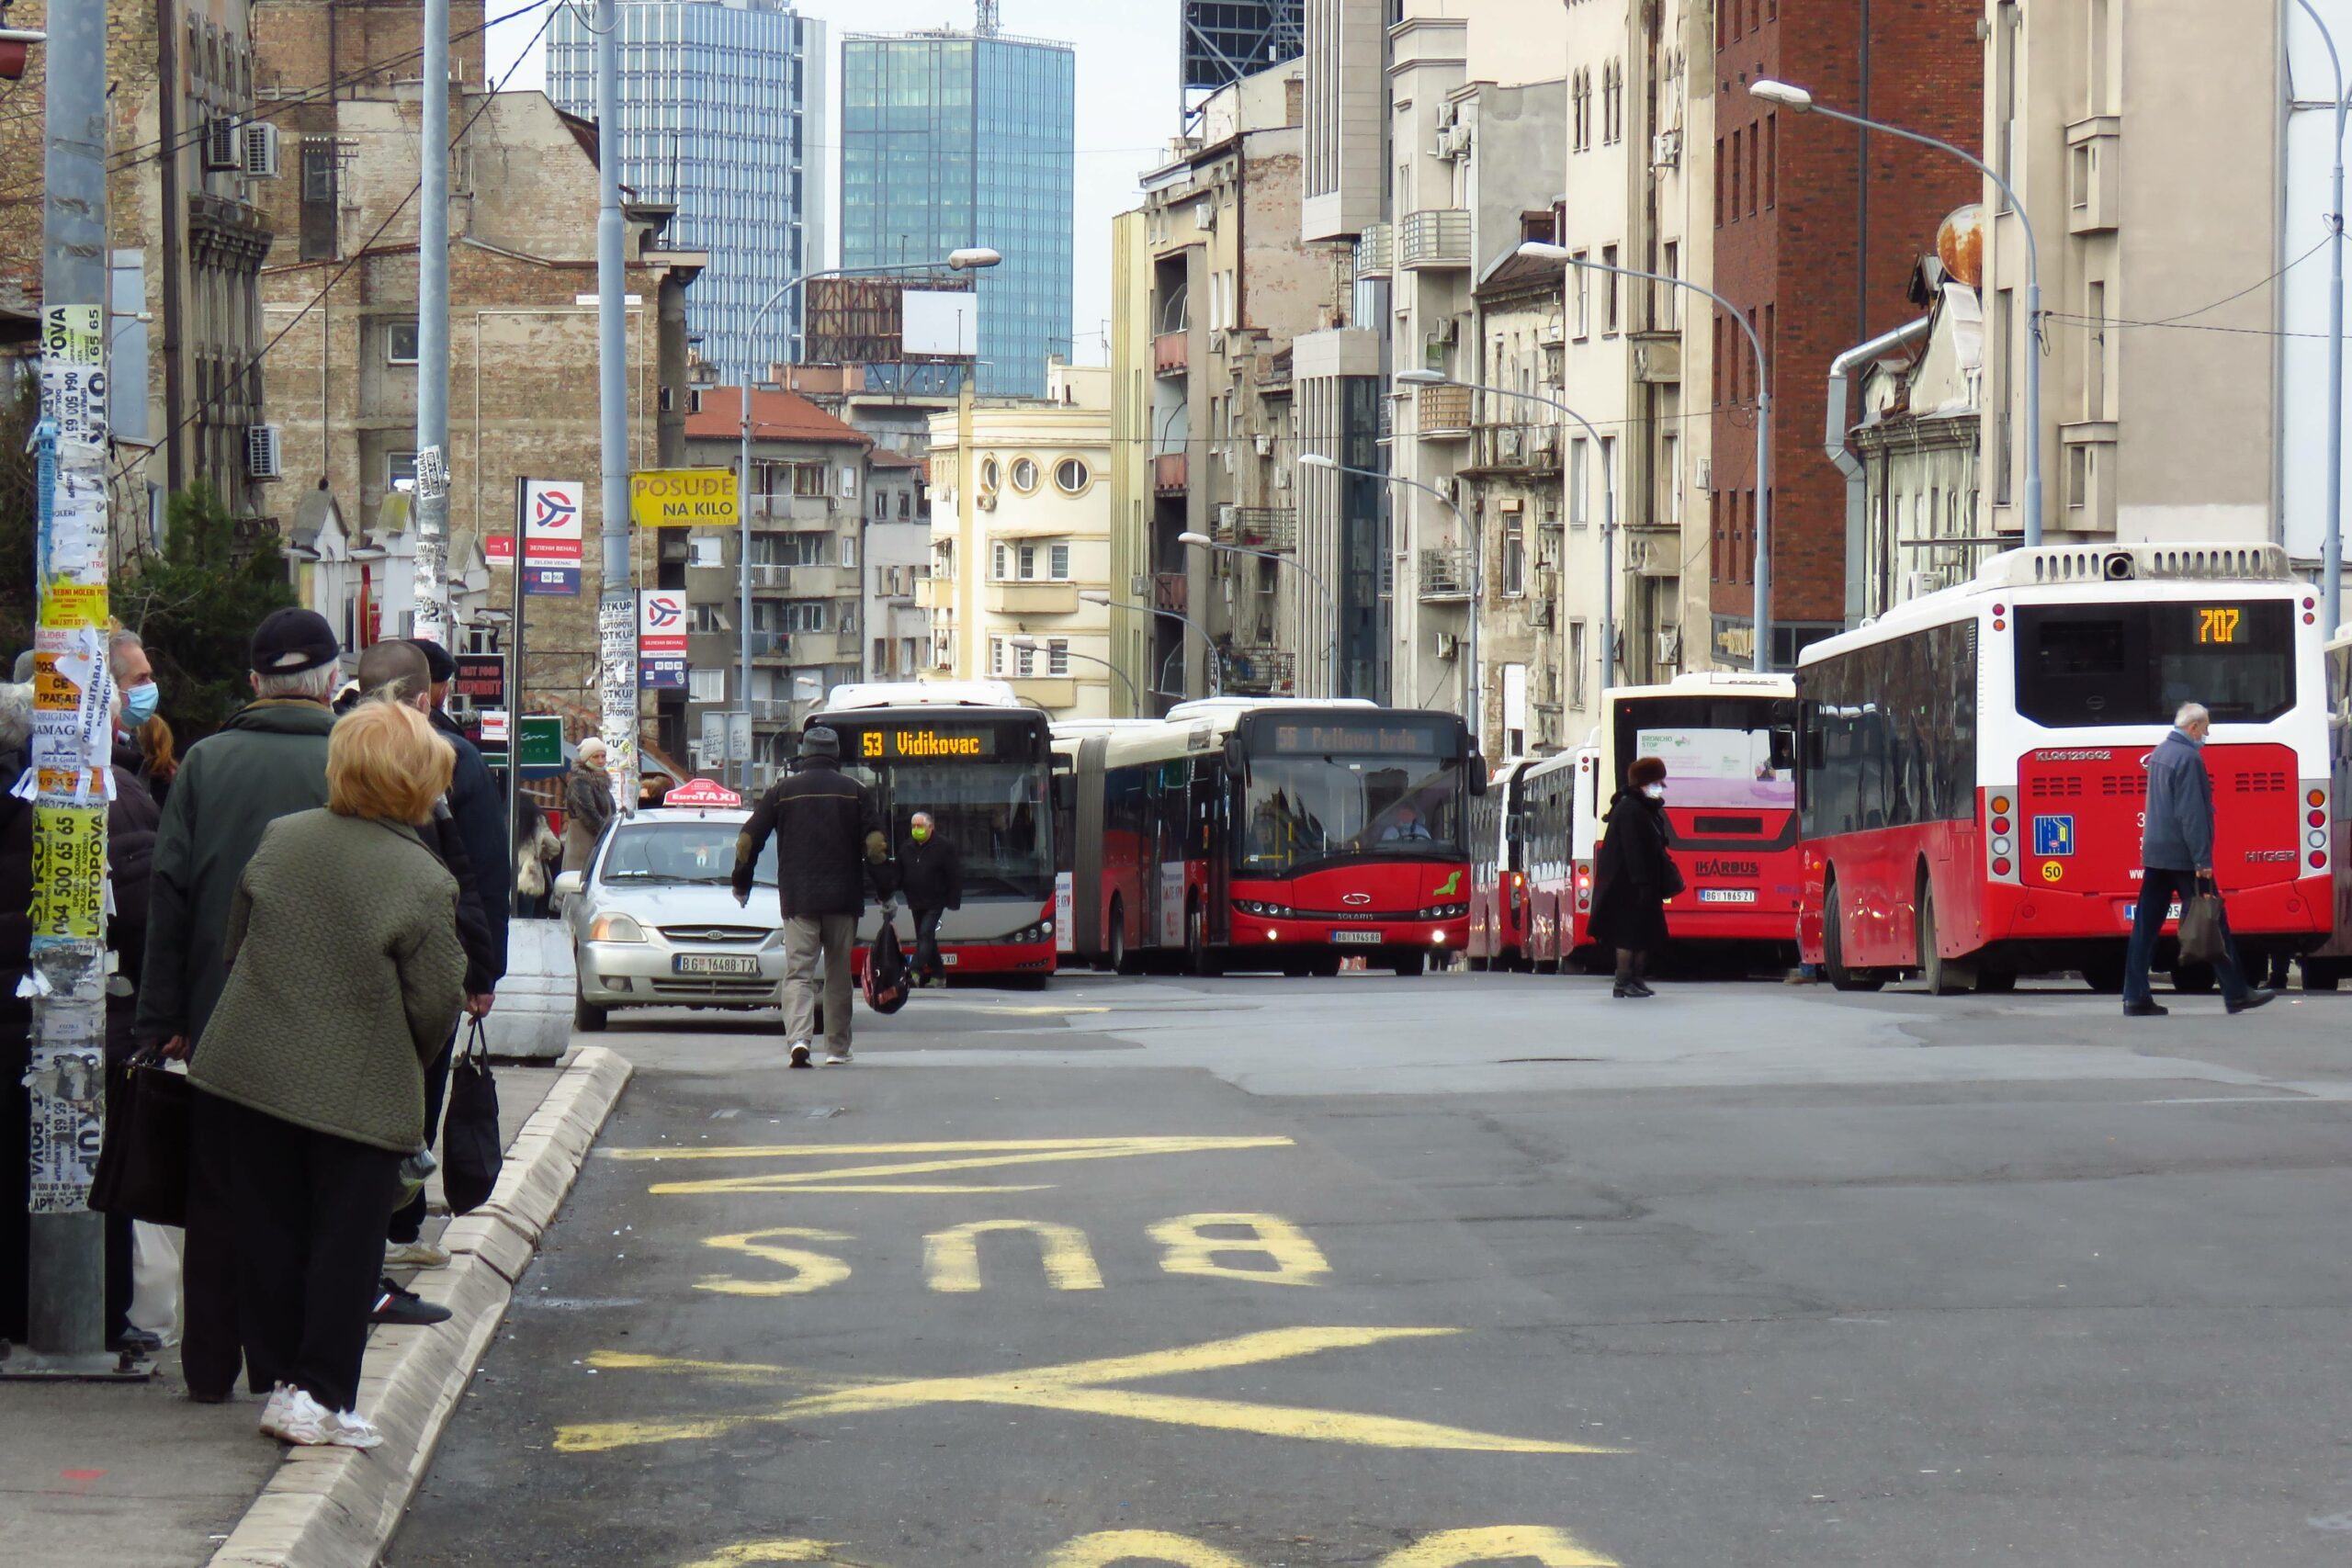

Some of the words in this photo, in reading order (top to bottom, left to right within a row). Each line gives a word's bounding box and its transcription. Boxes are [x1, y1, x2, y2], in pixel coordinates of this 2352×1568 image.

[88, 309, 99, 330] 65
[64, 372, 77, 391] 064
[419, 452, 432, 500] KAMAGRA
[636, 478, 733, 498] POSUĐE
[663, 502, 689, 516] NA
[695, 502, 733, 515] KILO
[503, 542, 509, 552] 1
[601, 601, 632, 612] OTKUP
[2199, 609, 2240, 643] 707
[603, 630, 634, 640] OTKUP
[603, 689, 634, 698] OTKUP
[864, 732, 882, 756] 53
[897, 731, 979, 755] Vidikovac
[673, 792, 736, 802] EuroTAXI
[56, 817, 74, 835] 65
[55, 842, 74, 861] 65
[2245, 851, 2296, 862] HIGER
[1696, 858, 1758, 874] IKARBUS
[2045, 866, 2061, 878] 50
[86, 812, 103, 936] LAPTOPOVA
[53, 867, 73, 898] 500
[1706, 891, 1716, 900] BG
[683, 957, 698, 970] BG
[54, 1102, 67, 1115] 65
[54, 1119, 67, 1132] 65
[692, 1212, 1332, 1296] BUS
